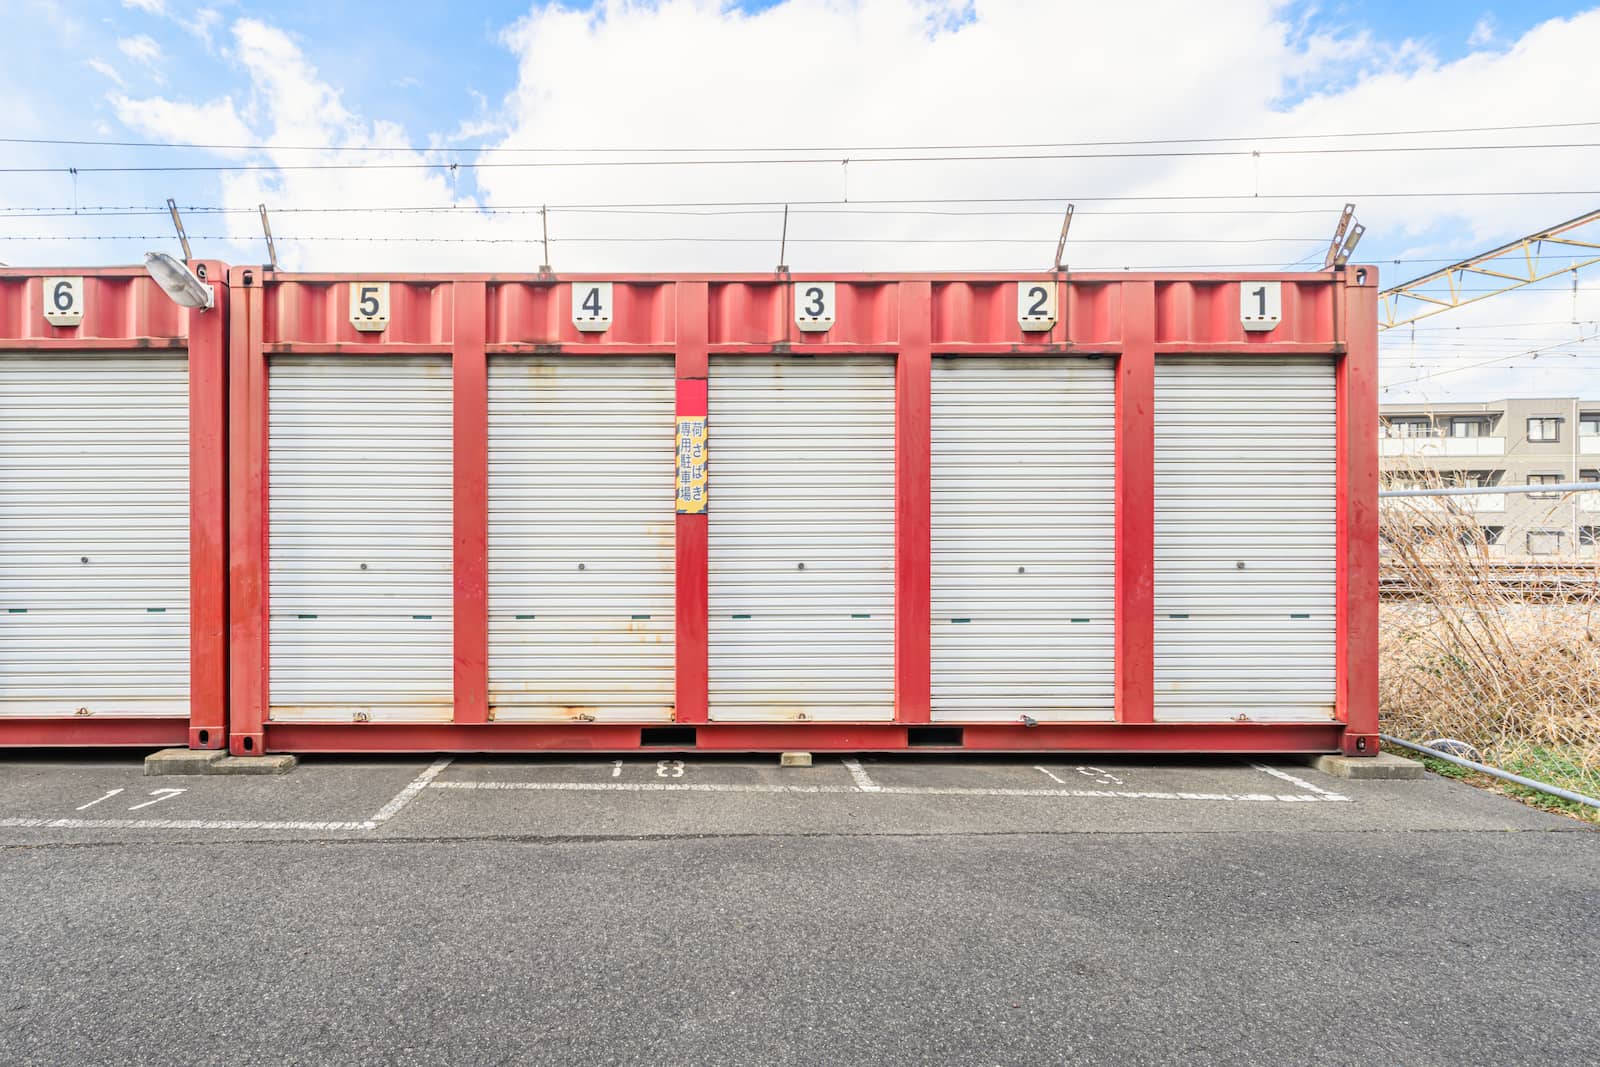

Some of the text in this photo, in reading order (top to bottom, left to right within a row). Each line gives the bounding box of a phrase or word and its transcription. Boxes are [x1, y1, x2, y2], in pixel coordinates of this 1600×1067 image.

[54, 281, 73, 311] 6
[360, 287, 379, 316] 5
[582, 287, 602, 316] 4
[804, 287, 825, 316] 3
[1028, 286, 1048, 315] 2
[1252, 286, 1266, 315] 1
[680, 421, 692, 502] 専用駐車場
[692, 421, 703, 501] 荷さばき
